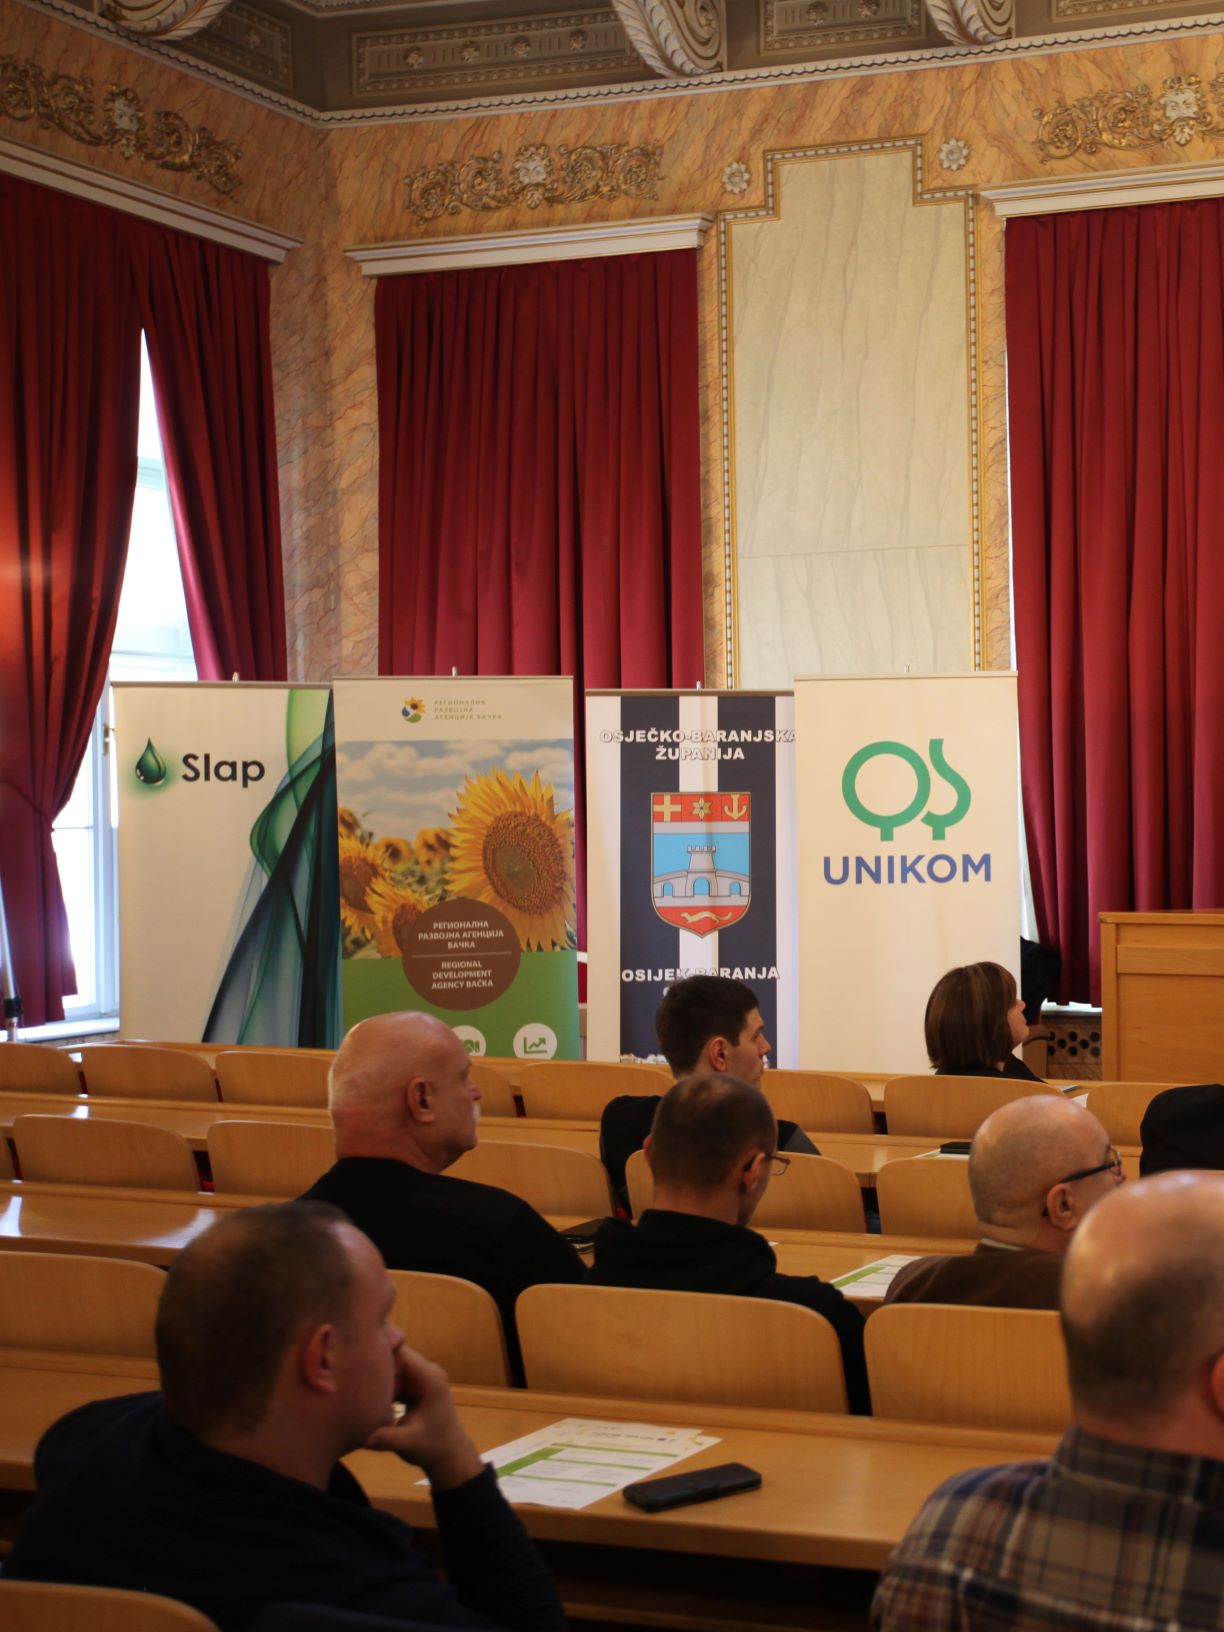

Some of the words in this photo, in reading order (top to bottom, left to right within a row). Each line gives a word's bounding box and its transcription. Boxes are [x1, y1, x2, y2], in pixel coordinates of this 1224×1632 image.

[656, 745, 745, 760] ŽUPANIJA
[182, 753, 265, 788] Slap
[823, 853, 991, 885] UNIKOM
[433, 920, 489, 930] РЕГИОНАЛНА
[418, 932, 460, 941] РАЗВОЈНА
[462, 930, 504, 940] АГЕНЦИЈА
[447, 941, 476, 950] БАЧКА
[441, 960, 483, 969] REGIONAL
[432, 970, 493, 980] DEVELOPMENT
[431, 981, 464, 990] AGENCY
[466, 979, 494, 989] BAČKA
